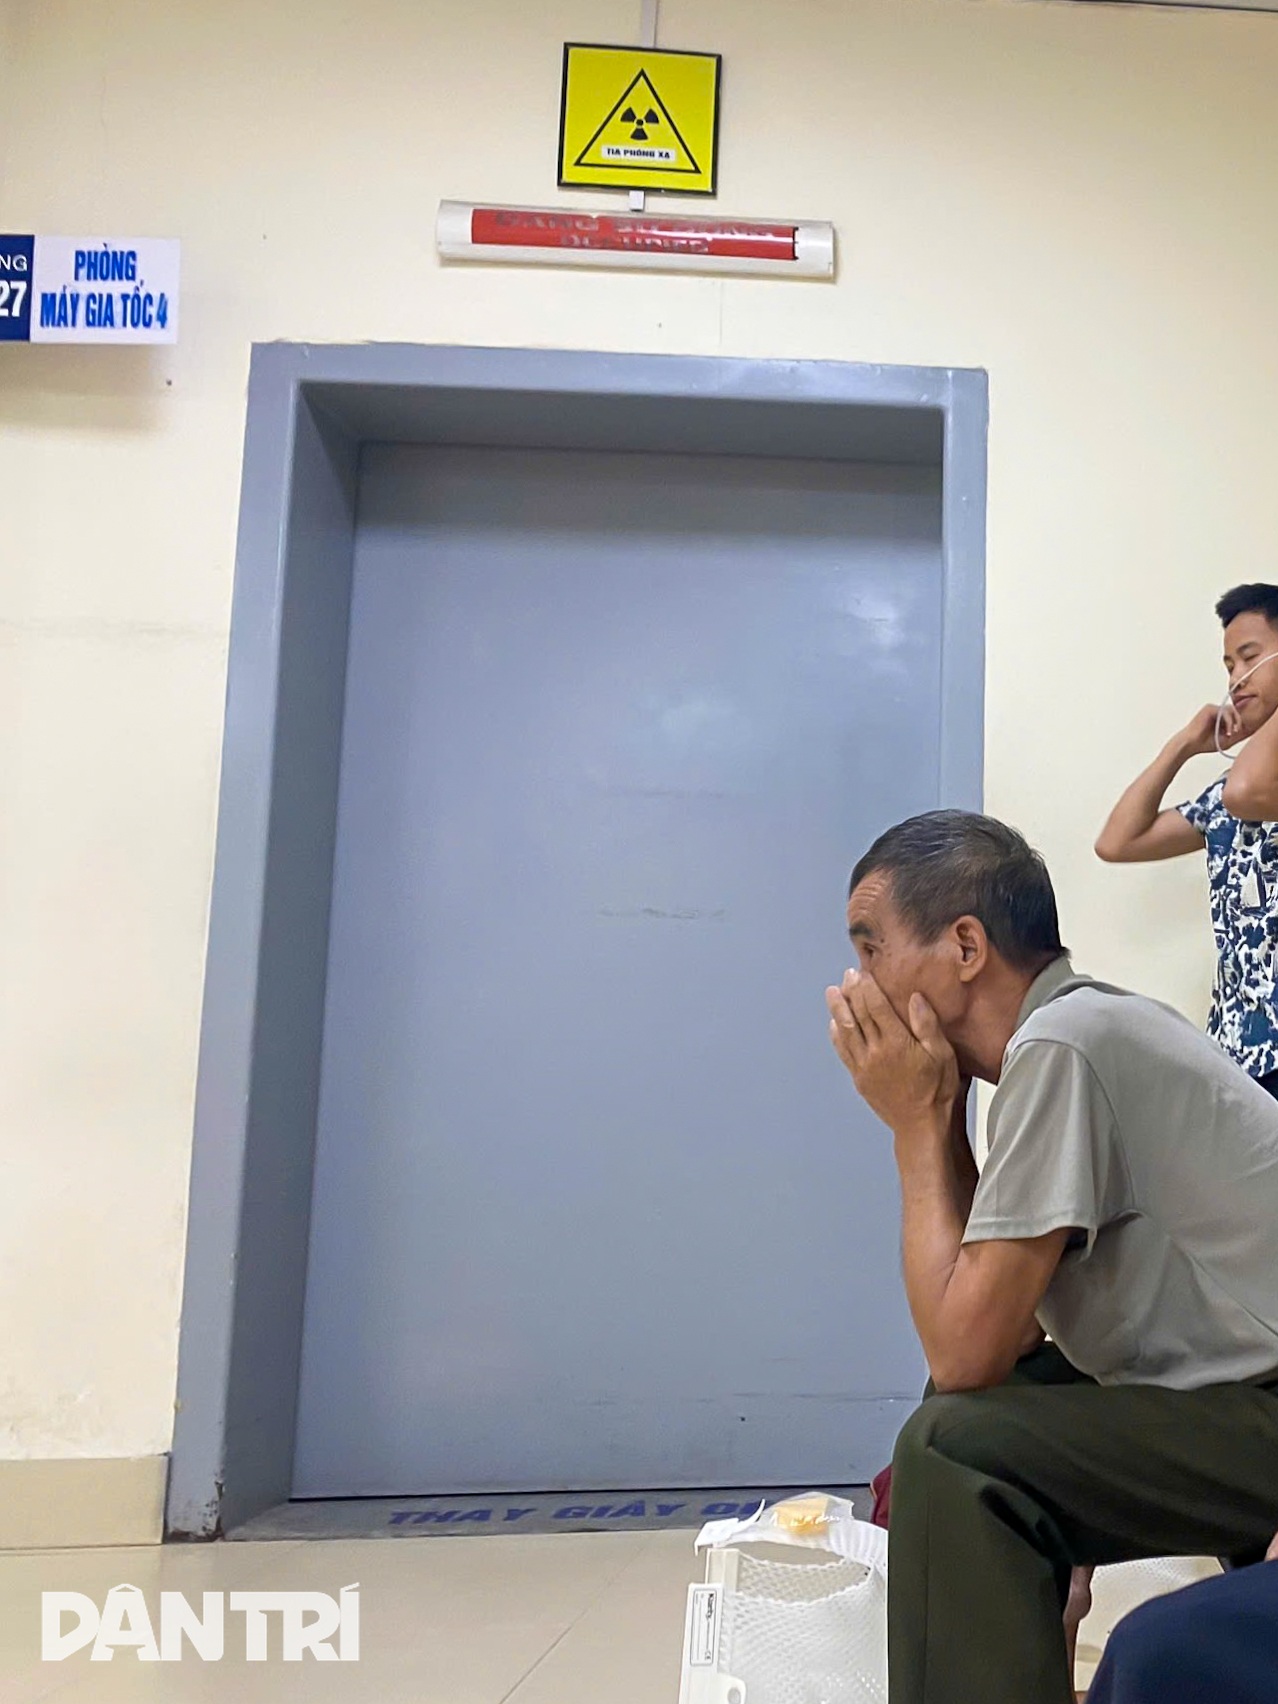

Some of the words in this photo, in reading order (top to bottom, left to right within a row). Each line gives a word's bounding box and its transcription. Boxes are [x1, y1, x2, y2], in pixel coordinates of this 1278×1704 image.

[606, 147, 621, 156] TIA
[74, 242, 138, 282] PHÒNG
[0, 279, 28, 318] 27
[40, 284, 80, 329] MÁY
[85, 292, 115, 329] GIA
[121, 278, 154, 329] TỐC
[156, 292, 168, 329] 4
[388, 1507, 538, 1526] THAY
